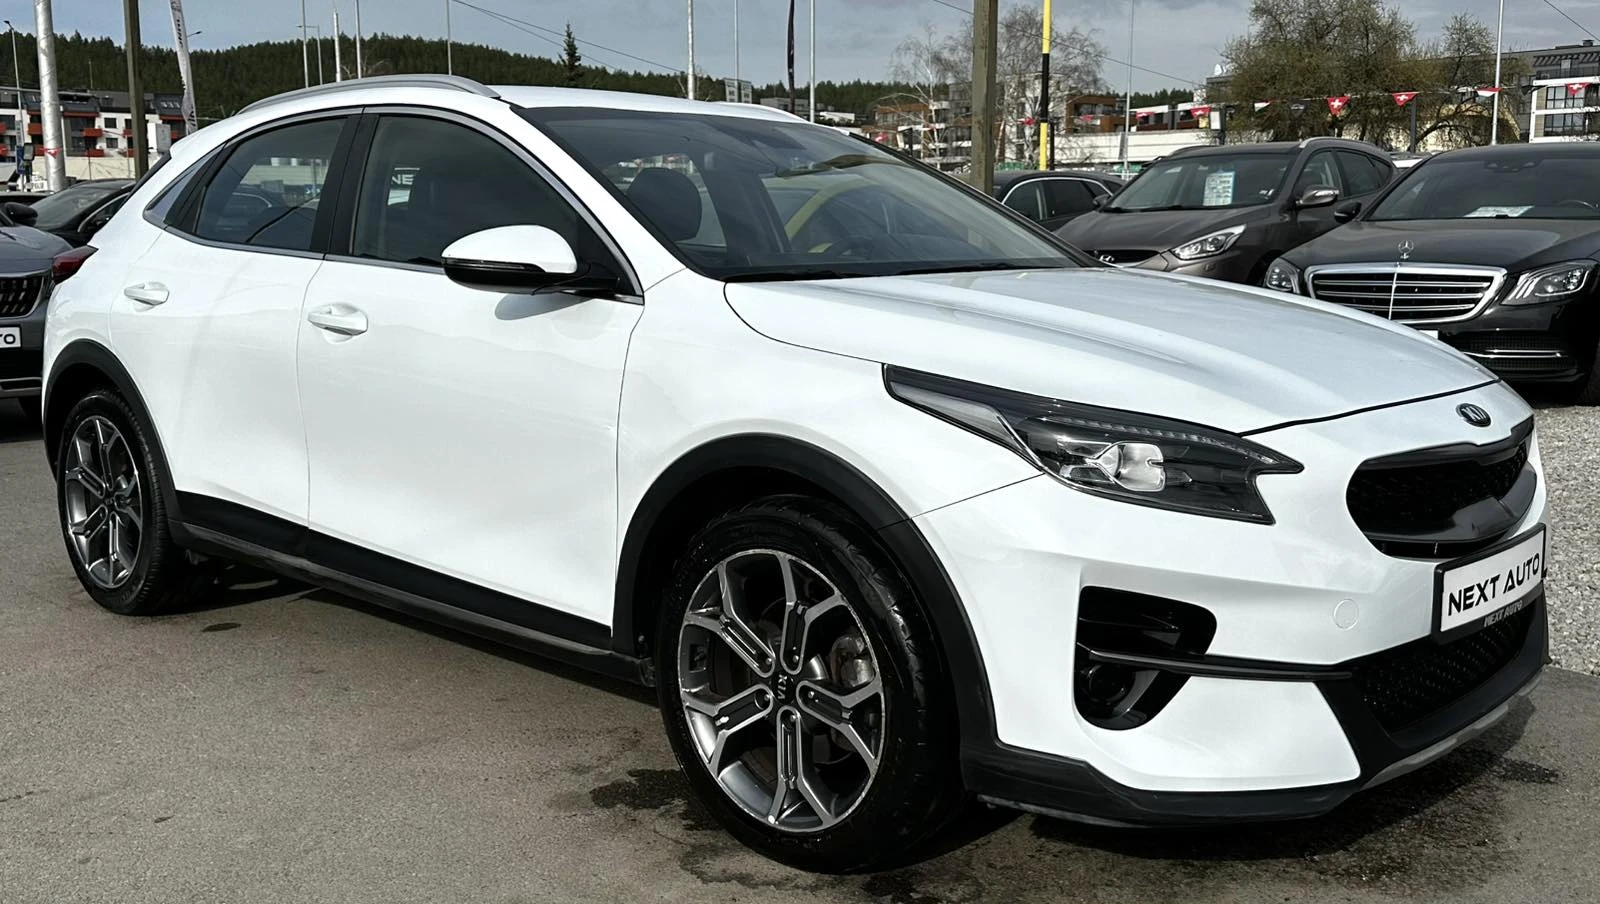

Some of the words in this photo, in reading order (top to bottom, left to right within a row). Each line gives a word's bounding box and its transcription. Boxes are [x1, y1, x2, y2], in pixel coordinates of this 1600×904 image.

[1448, 574, 1501, 616] NEXT
[1503, 553, 1540, 594] AUTO
[1484, 609, 1504, 627] NEXT
[1504, 600, 1522, 618] AUTO
[778, 673, 788, 700] KIA
